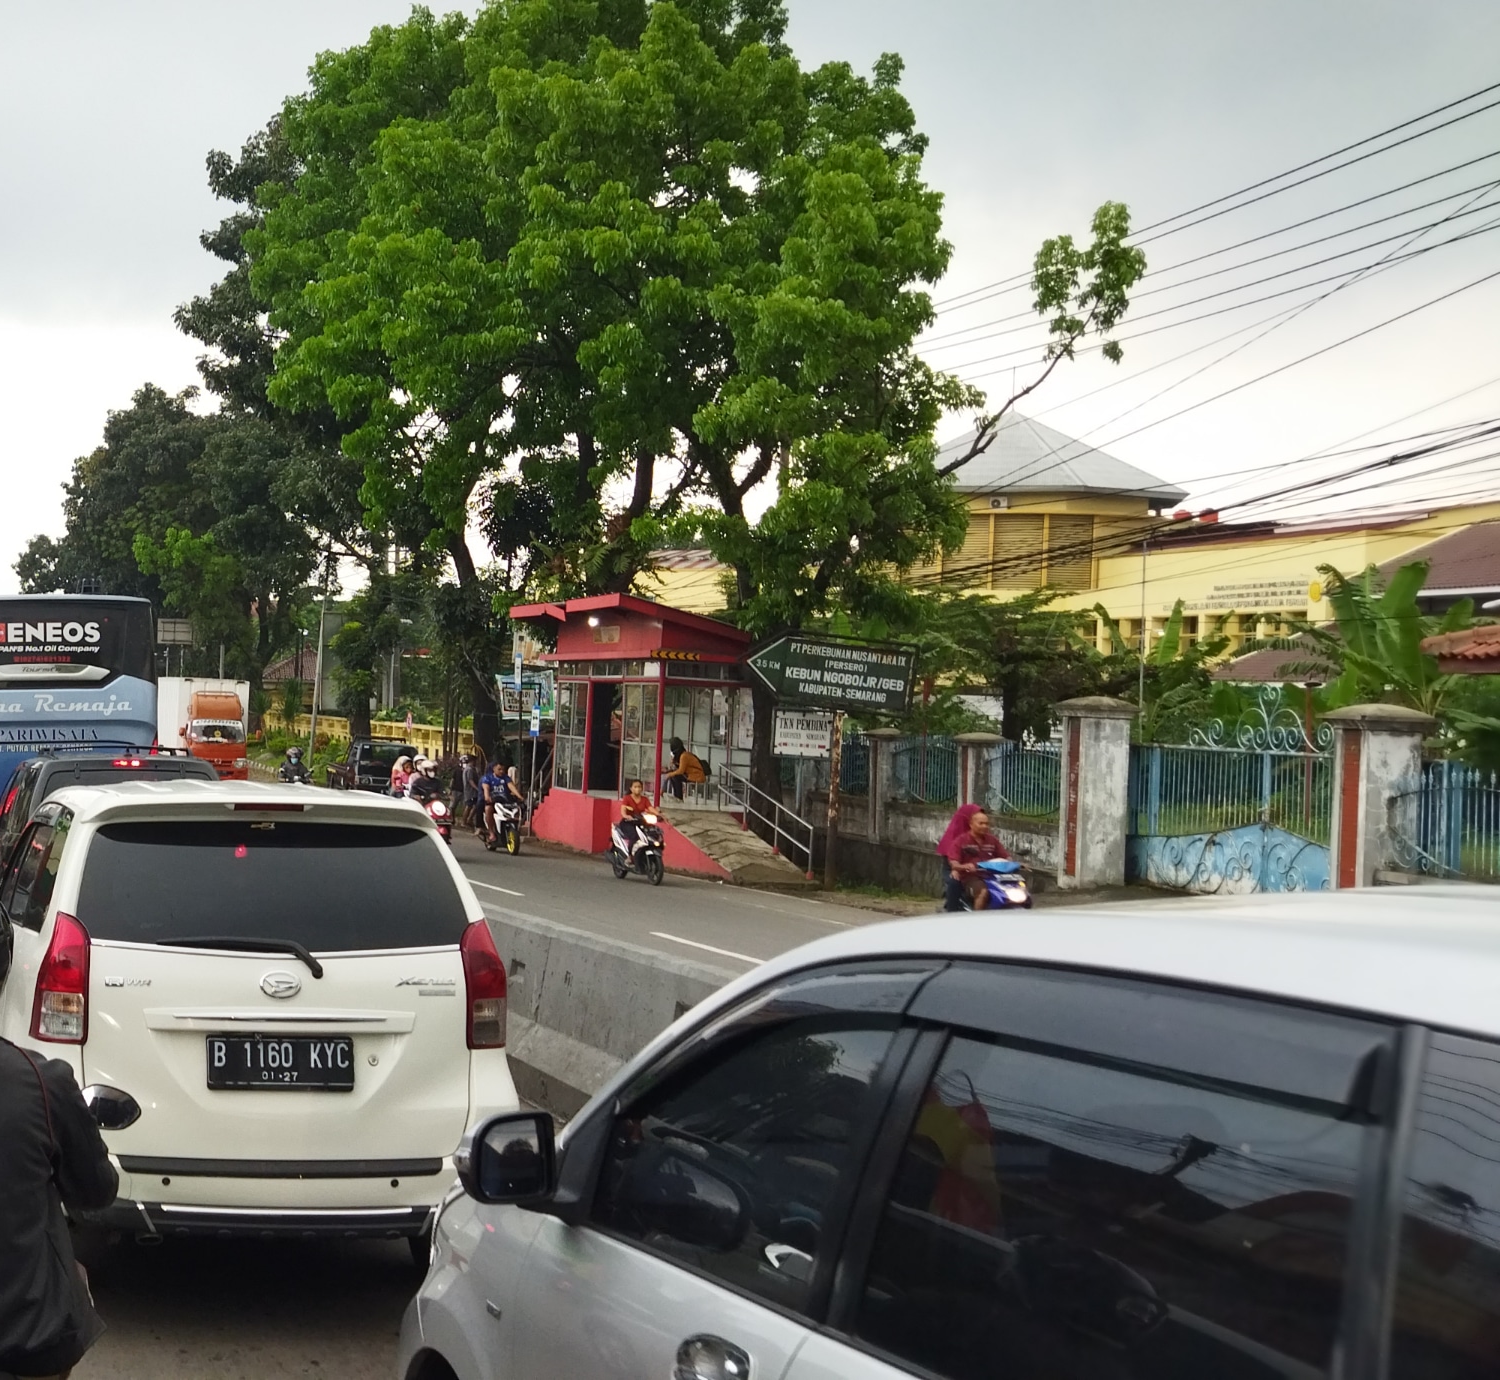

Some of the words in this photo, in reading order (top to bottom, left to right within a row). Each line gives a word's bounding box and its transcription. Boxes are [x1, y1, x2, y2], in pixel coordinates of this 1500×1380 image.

[7, 622, 100, 643] ENEOS
[57, 645, 100, 653] Company
[791, 642, 801, 653] PT
[801, 644, 851, 659] PERKEBUNAN
[852, 651, 898, 665] NUSANTARA
[898, 656, 906, 667] IX
[769, 659, 780, 670] KM
[825, 660, 868, 673] (PERSERO)
[786, 666, 821, 682] KEBUN
[34, 694, 133, 717] Remaja
[780, 718, 794, 729] TKN
[797, 719, 828, 732] PEMBINA
[7, 744, 28, 752] PUTRA
[214, 1041, 226, 1067] B
[244, 1041, 294, 1068] 1160
[310, 1042, 350, 1069] KYC
